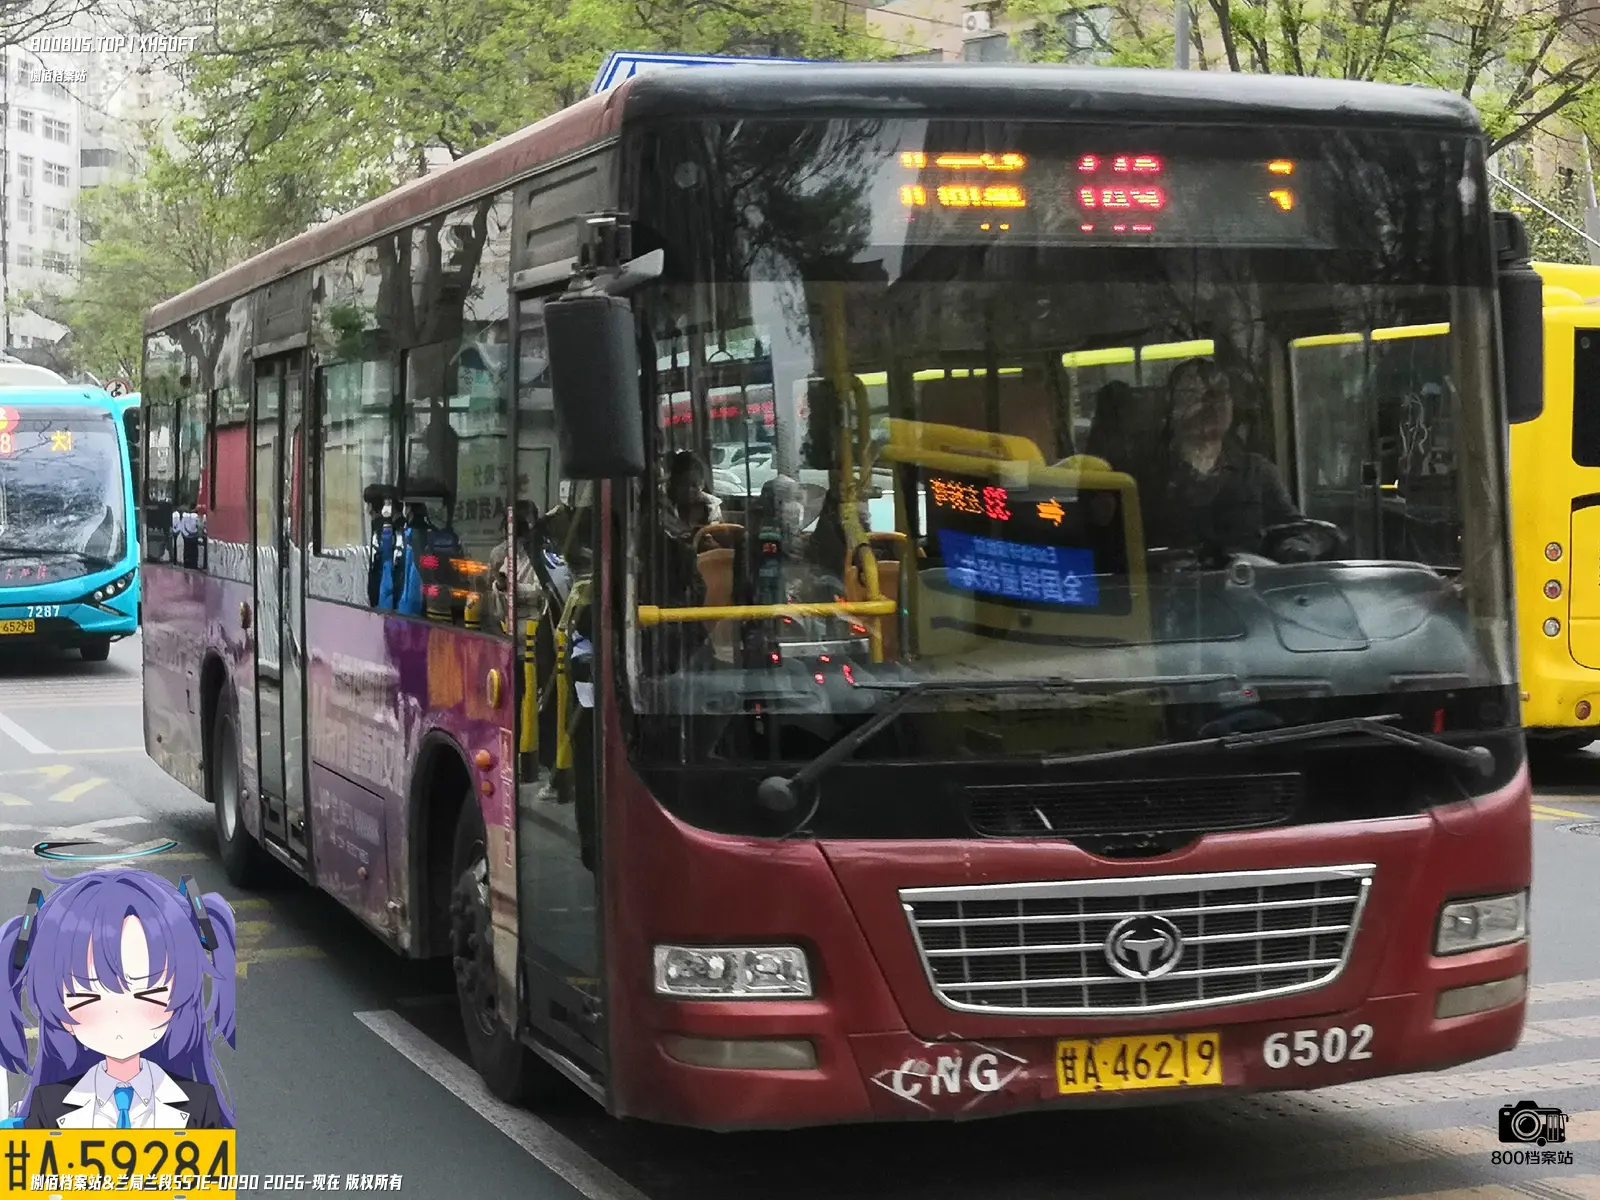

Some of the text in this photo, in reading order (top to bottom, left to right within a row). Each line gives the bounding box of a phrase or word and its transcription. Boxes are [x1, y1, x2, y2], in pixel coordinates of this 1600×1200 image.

[27, 604, 60, 618] 7287
[1263, 1024, 1374, 1070] 6502
[892, 1053, 1000, 1097] CNG
